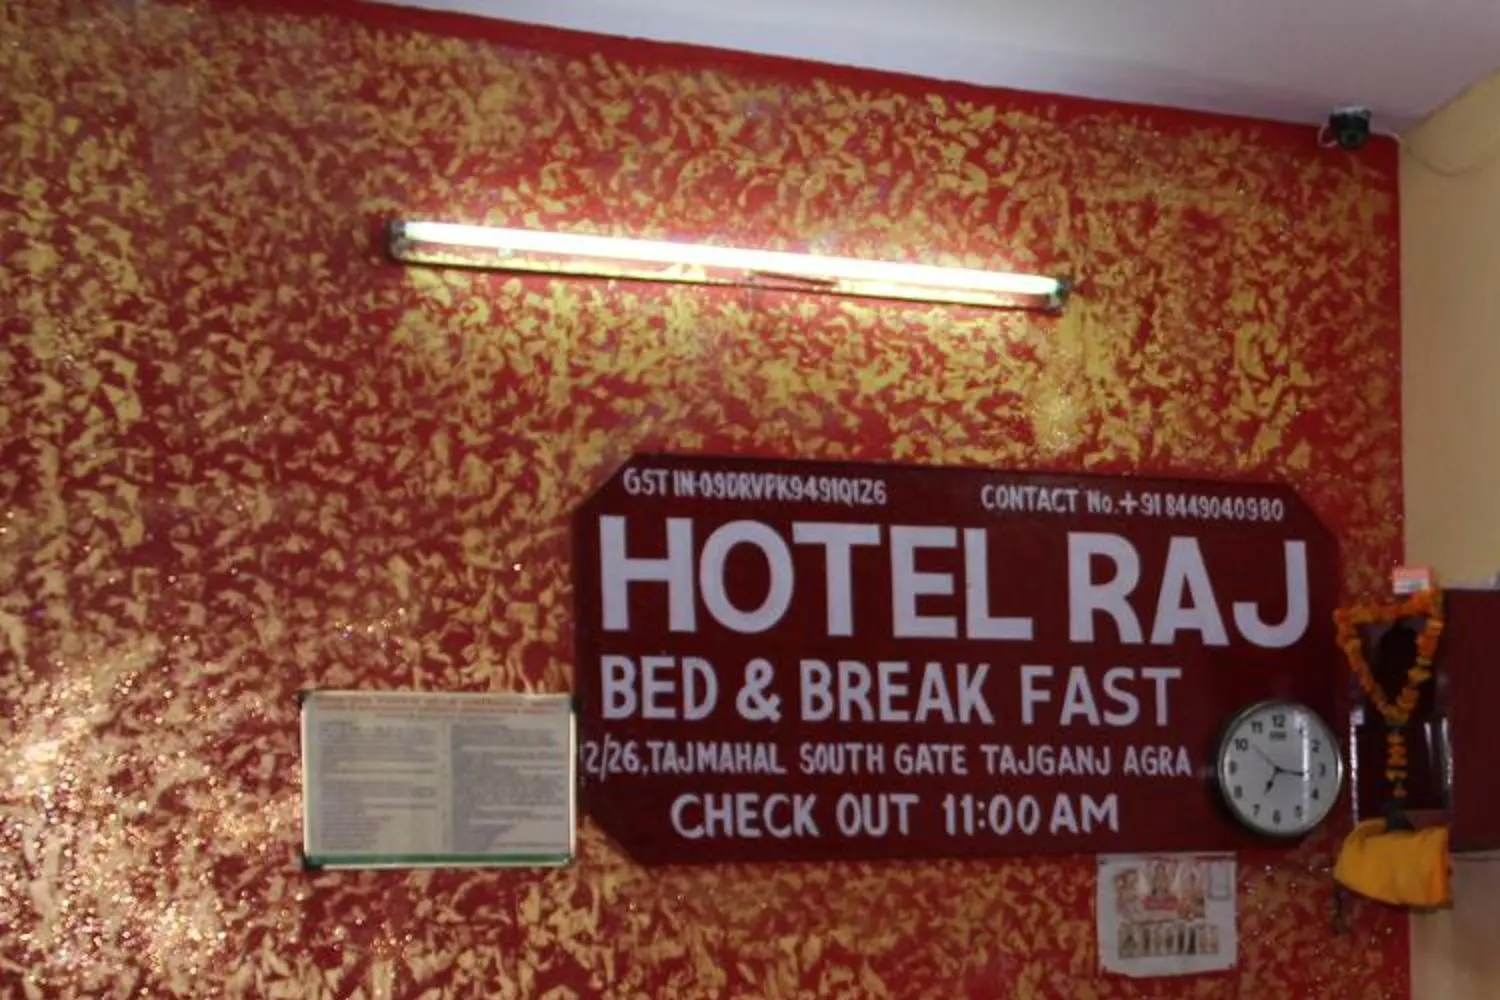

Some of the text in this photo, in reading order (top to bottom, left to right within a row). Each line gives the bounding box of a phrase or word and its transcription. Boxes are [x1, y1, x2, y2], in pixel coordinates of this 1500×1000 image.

[623, 467, 669, 496] GST
[981, 484, 1079, 513] CONTACT
[600, 514, 1310, 648] HOTEL RAJ
[600, 654, 1182, 727] BED & BREAK FAST
[800, 742, 885, 775] SOUTH
[894, 744, 968, 776] GATE
[980, 744, 1111, 776] TAJGANJ
[1123, 745, 1192, 777] AGRA
[670, 792, 1120, 839] CHECK OUT 11:00 AM
